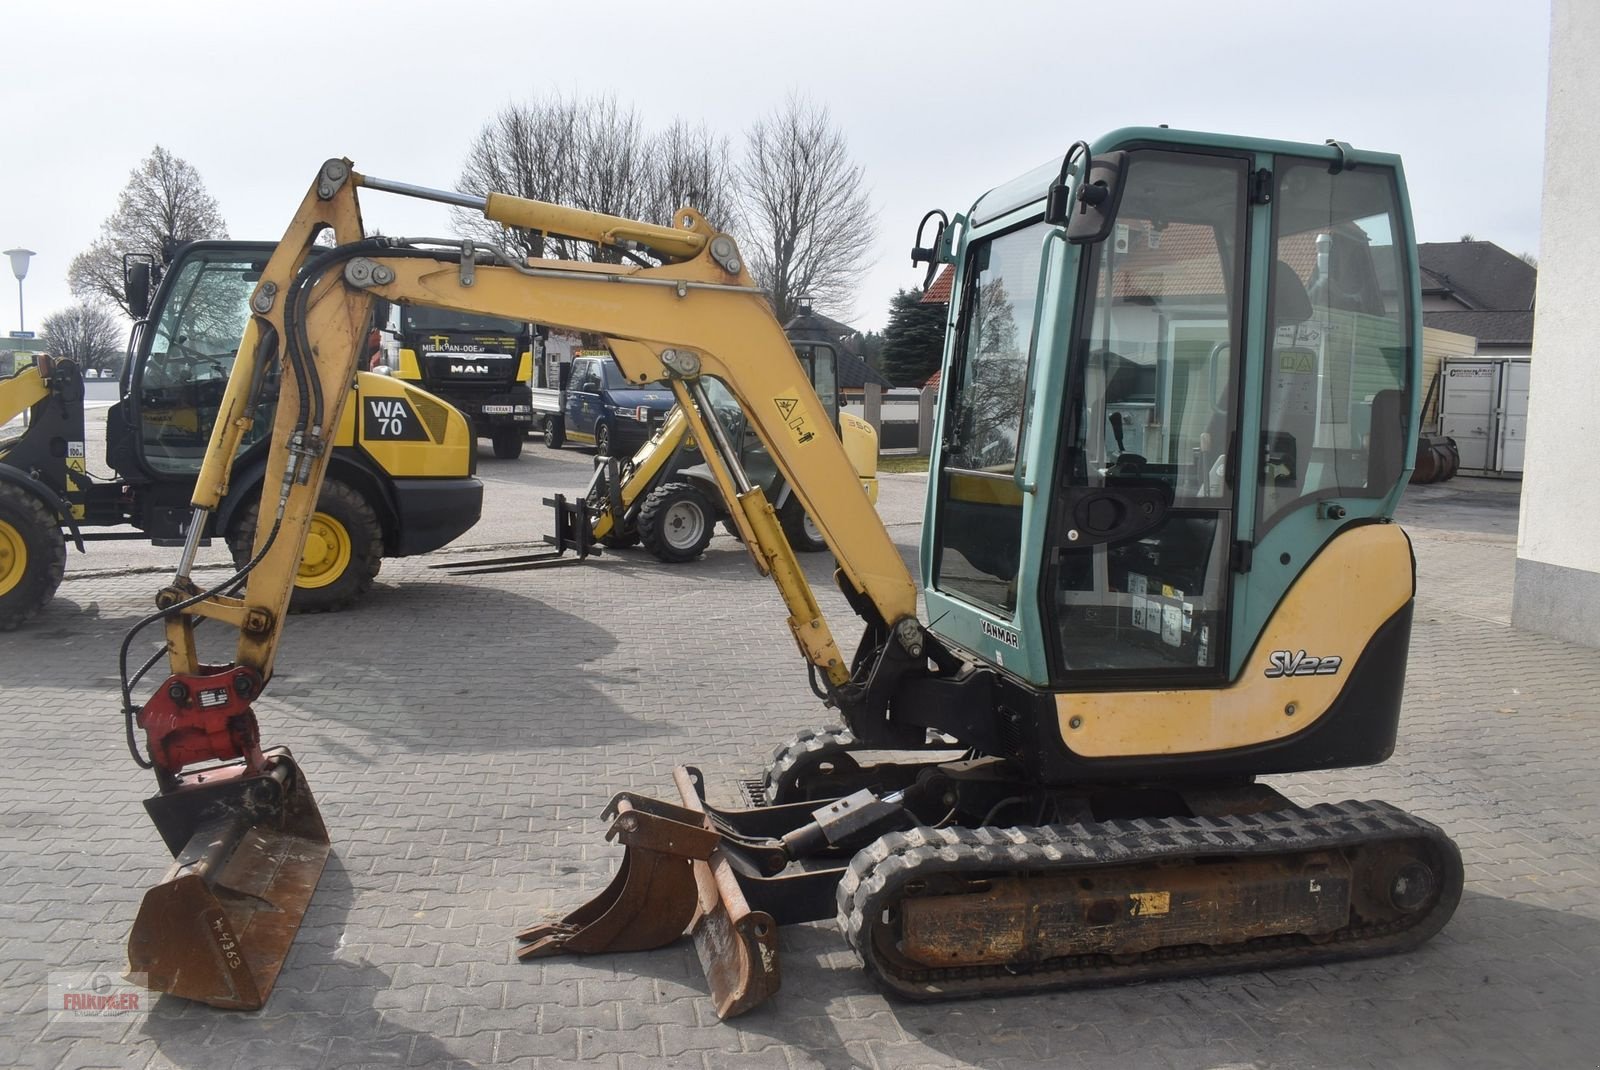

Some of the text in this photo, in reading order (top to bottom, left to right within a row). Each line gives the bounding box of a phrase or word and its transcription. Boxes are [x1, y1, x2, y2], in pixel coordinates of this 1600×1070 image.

[451, 365, 488, 373] MAN
[370, 401, 407, 418] WA
[378, 418, 402, 435] 70
[979, 618, 1019, 649] YANMAR
[1264, 650, 1342, 678] SV22
